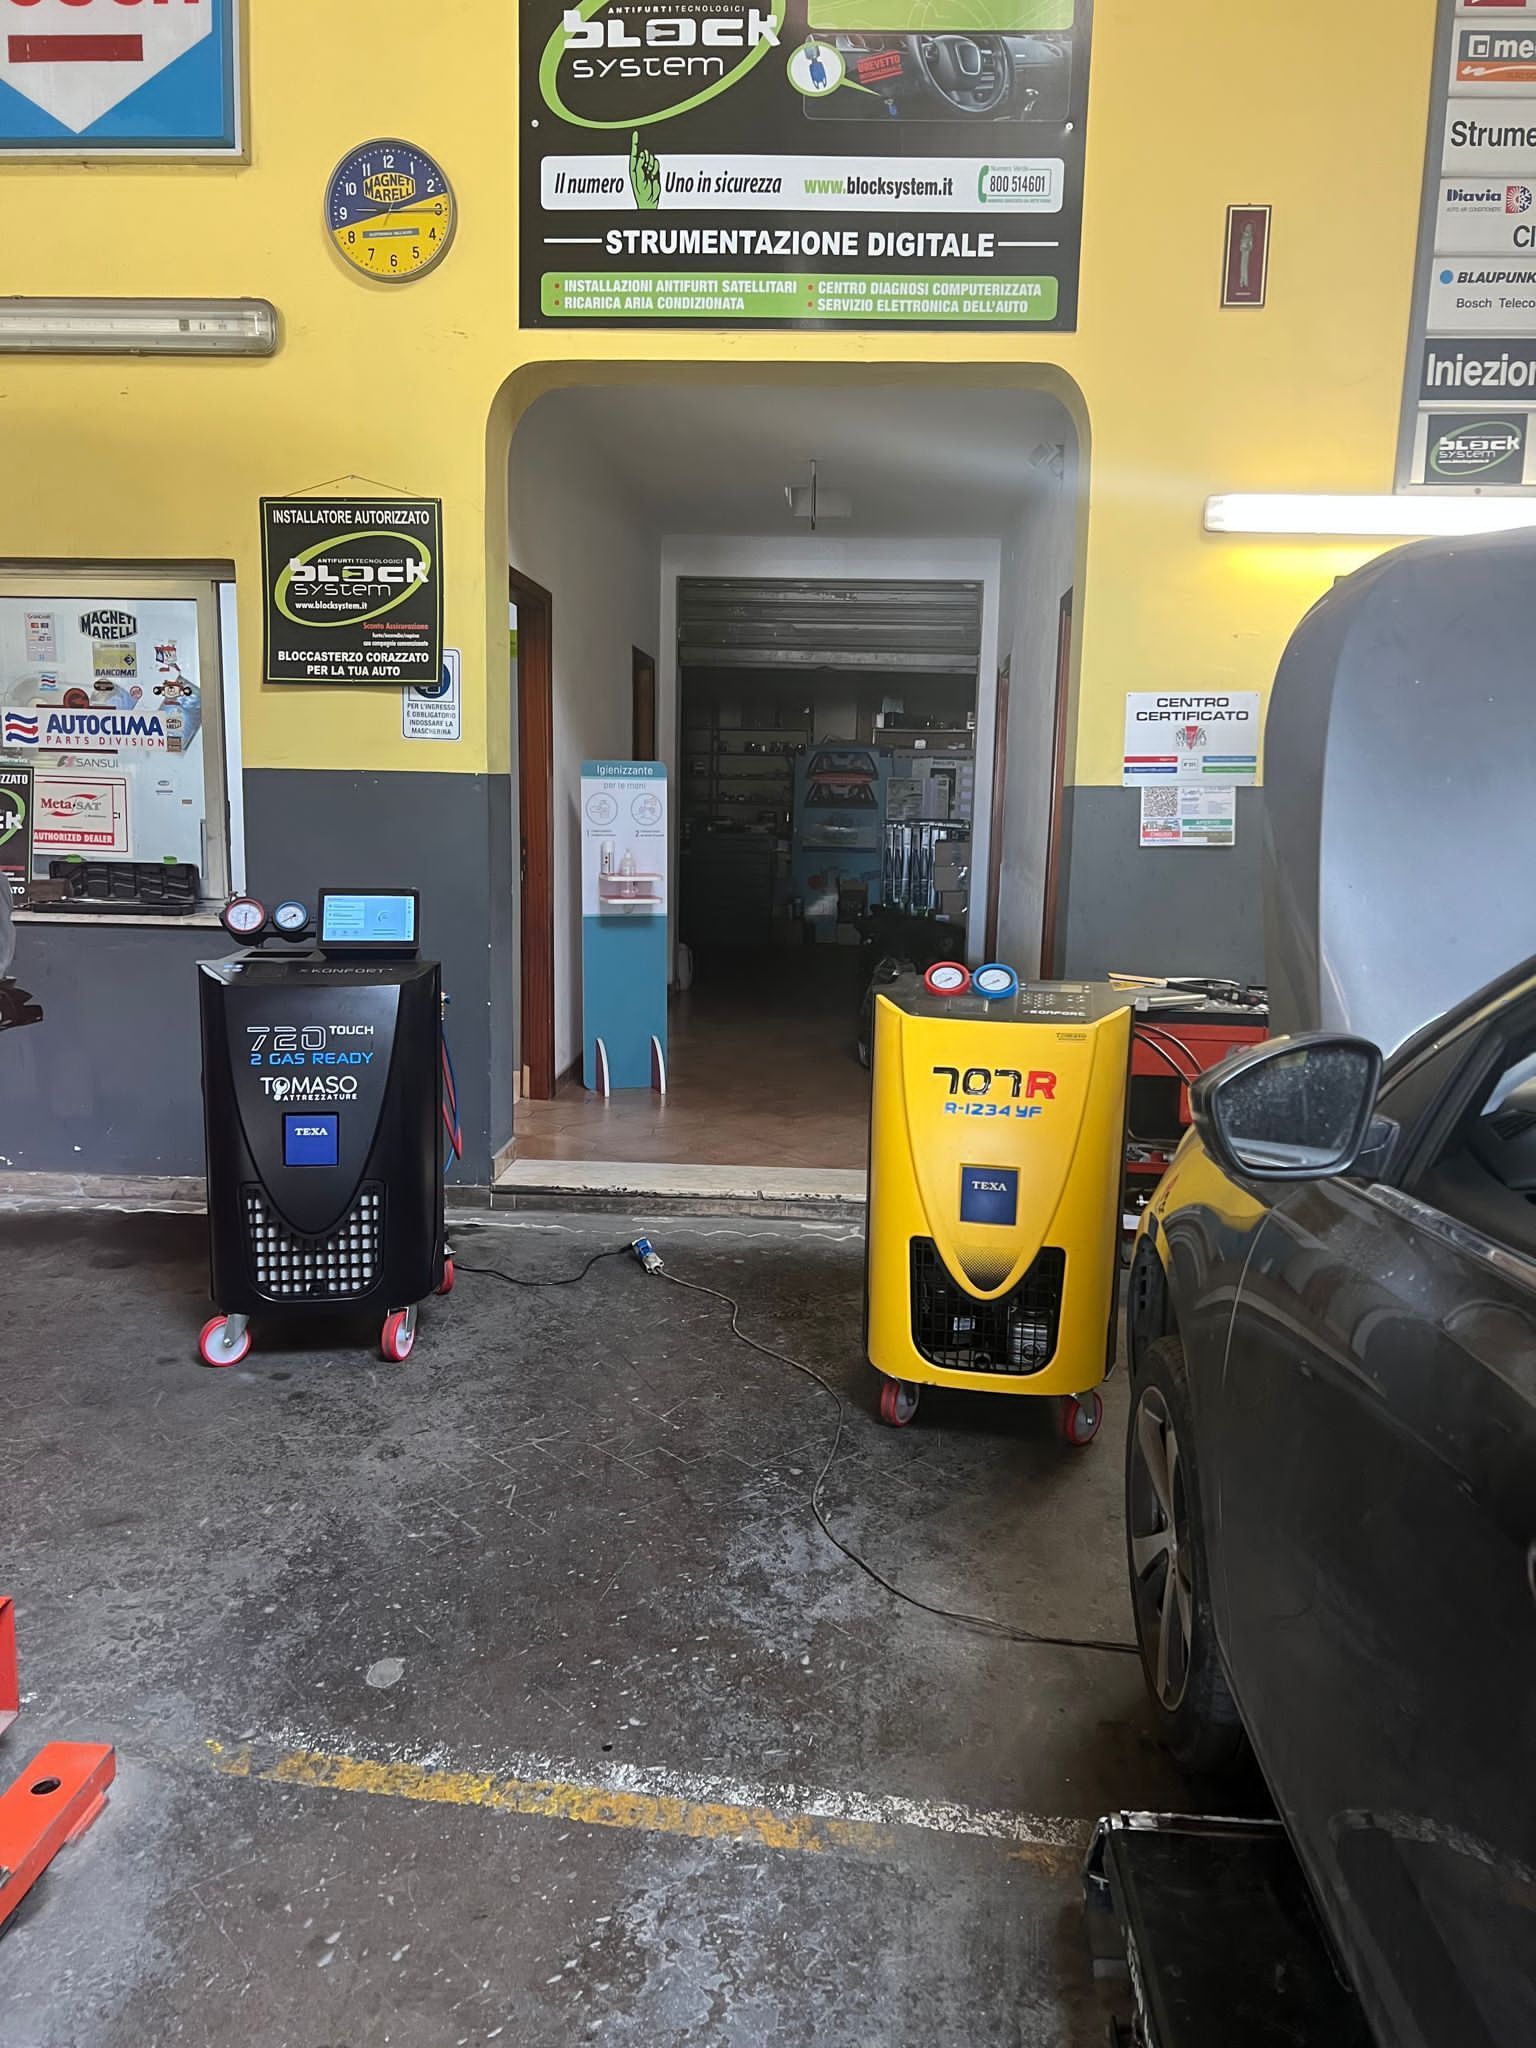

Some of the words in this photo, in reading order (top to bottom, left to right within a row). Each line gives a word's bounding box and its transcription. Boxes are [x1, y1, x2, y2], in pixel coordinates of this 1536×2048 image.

[607, 6, 672, 14] ANTIFURTI
[674, 5, 745, 13] TECNOLOGICI
[1494, 40, 1536, 58] me
[572, 56, 724, 79] system
[383, 155, 394, 169] 12
[410, 160, 414, 176] 1
[362, 162, 371, 177] 11
[345, 181, 357, 196] 10
[426, 179, 435, 193] 2
[554, 172, 566, 194] Il
[567, 177, 624, 194] numero
[665, 172, 694, 194] Uno
[697, 170, 712, 194] in
[714, 170, 783, 194] sicurezza
[804, 176, 954, 200] www.blocksystem.it
[990, 175, 1009, 192] 800
[1011, 175, 1046, 192] 514601
[1447, 189, 1502, 201] Diavia
[340, 206, 348, 220] 9
[348, 230, 356, 244] 8
[429, 227, 436, 241] 4
[605, 229, 859, 256] STRUMENTAZIONE
[867, 231, 994, 258] DIGITALE
[368, 248, 375, 262] 7
[412, 246, 420, 259] 5
[390, 254, 398, 267] 6
[564, 280, 653, 293] INSTALLAZIONI
[655, 280, 718, 293] ANTIFURTI
[721, 280, 797, 294] SATELLITARI
[818, 281, 867, 294] CENTRO
[870, 282, 929, 295] DIAGNOSI
[932, 283, 1041, 297] COMPUTERIZZATA
[564, 296, 622, 309] RICARICA
[624, 296, 654, 310] ARIA
[656, 297, 745, 310] CONDIZIONATA
[817, 298, 873, 312] SERVIZIO
[876, 299, 959, 312] ELETTRONICA
[1456, 298, 1492, 309] Bosch
[1438, 450, 1496, 459] system
[273, 509, 353, 524] INSTALLATORE
[354, 510, 430, 525] AUTORIZZATO
[294, 583, 391, 597] system
[295, 600, 368, 611] www.blocksystem.it
[277, 650, 363, 662] BLOCCASTERZO
[365, 652, 430, 663] CORAZZATO
[306, 665, 328, 675] PER
[331, 665, 345, 676] LA
[347, 665, 369, 676] TUA
[371, 666, 401, 677] AUTO
[1156, 697, 1230, 707] CENTRO
[1136, 711, 1249, 721] CERTIFICATO
[46, 713, 164, 736] AUTOCLIMA
[46, 736, 90, 745] PARTS
[99, 737, 165, 747] DIVISION
[76, 758, 119, 769] SANSUI
[597, 764, 654, 776] Igienizzante
[41, 798, 72, 809] Meta
[34, 831, 82, 843] AUTHORIZED
[84, 833, 113, 844] DEALER
[247, 1026, 326, 1051] 720
[329, 1025, 374, 1035] TOUCH
[250, 1053, 262, 1065] 2
[269, 1053, 305, 1065] GAS
[312, 1052, 374, 1065] READY
[260, 1075, 358, 1095] TOMASO
[294, 1127, 328, 1136] TEXA
[972, 1180, 1007, 1192] TEXA
